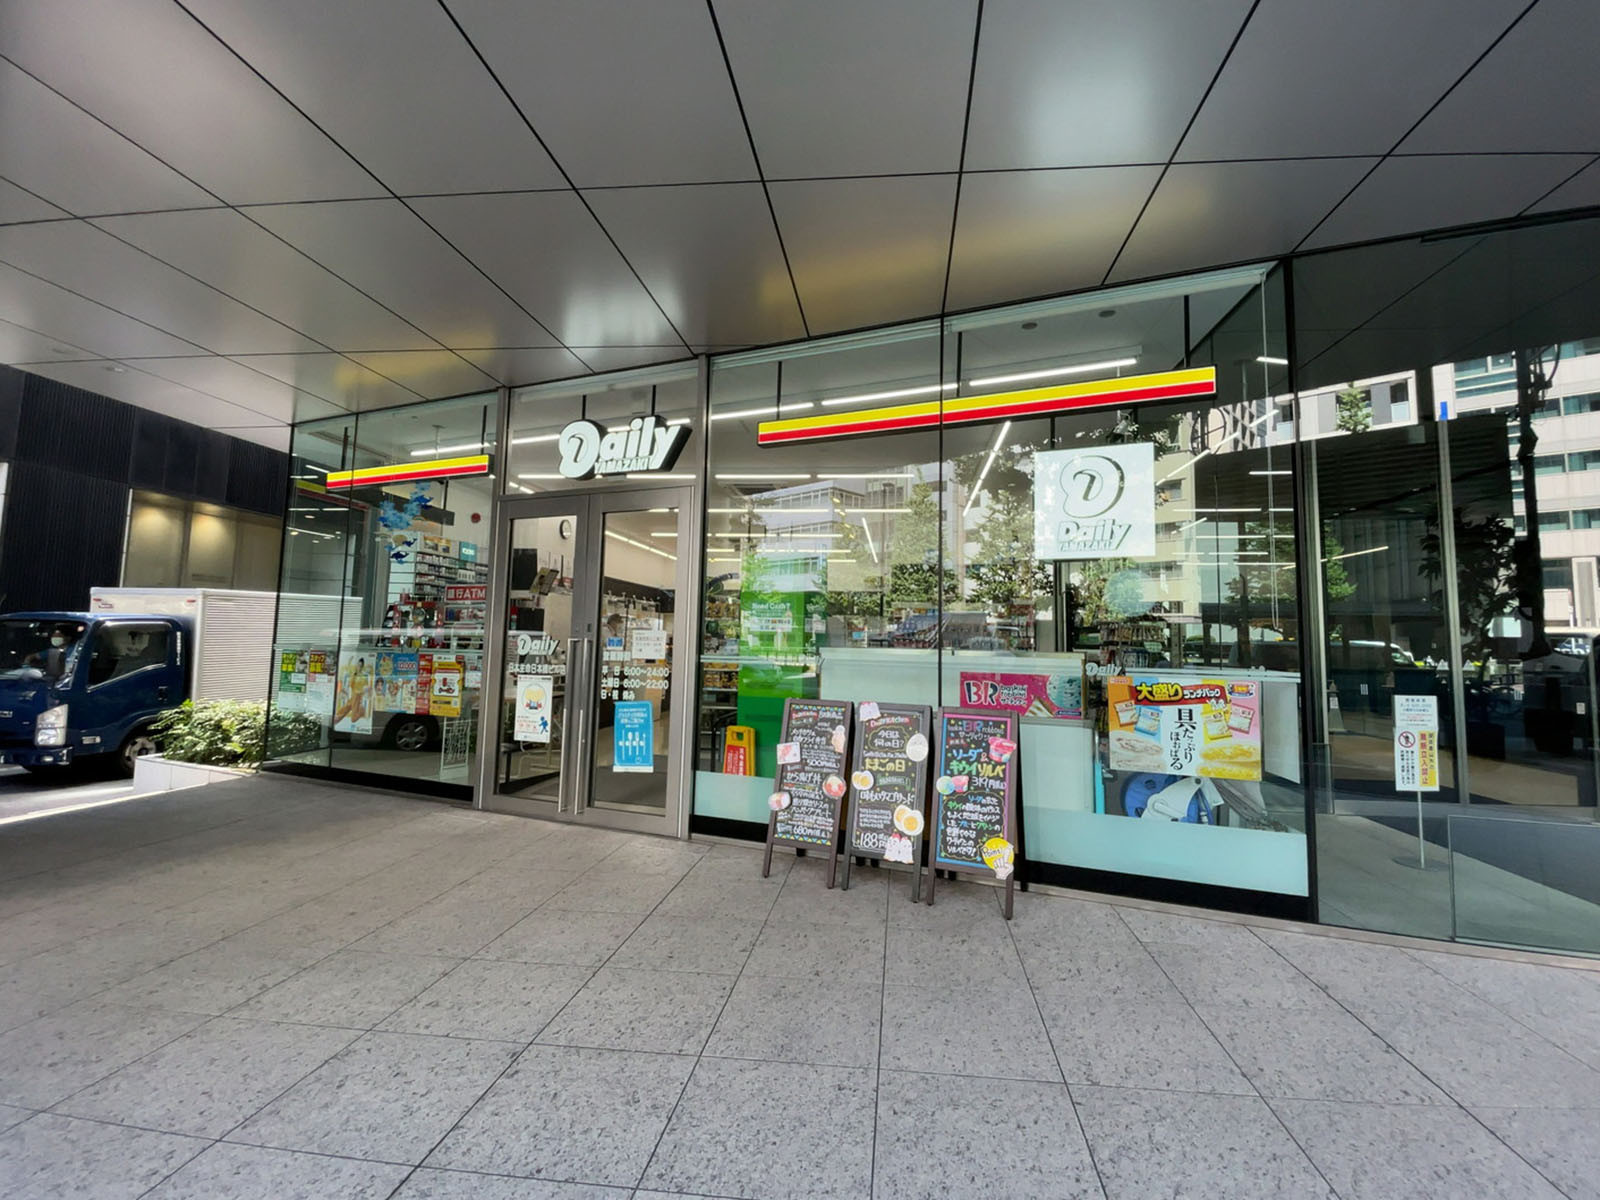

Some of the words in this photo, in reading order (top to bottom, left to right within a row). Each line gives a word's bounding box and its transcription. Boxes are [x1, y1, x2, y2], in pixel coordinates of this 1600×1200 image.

[558, 416, 681, 478] Daily
[595, 457, 650, 475] YAMAZAKI
[1057, 518, 1132, 551] Daily
[517, 634, 560, 656] Daily
[1085, 662, 1122, 677] Daily
[964, 680, 1000, 706] BR
[1136, 682, 1183, 702] 大盛り
[1183, 687, 1221, 700] ランチパック
[878, 730, 900, 738] 今日は
[963, 720, 984, 732] BR
[874, 738, 905, 748] 何の日?
[1174, 708, 1198, 764] 具たっぷり
[952, 748, 983, 762] ソーダ
[1169, 731, 1184, 770] ほおばる
[865, 757, 906, 772] たまごの日
[860, 832, 878, 848] 188
